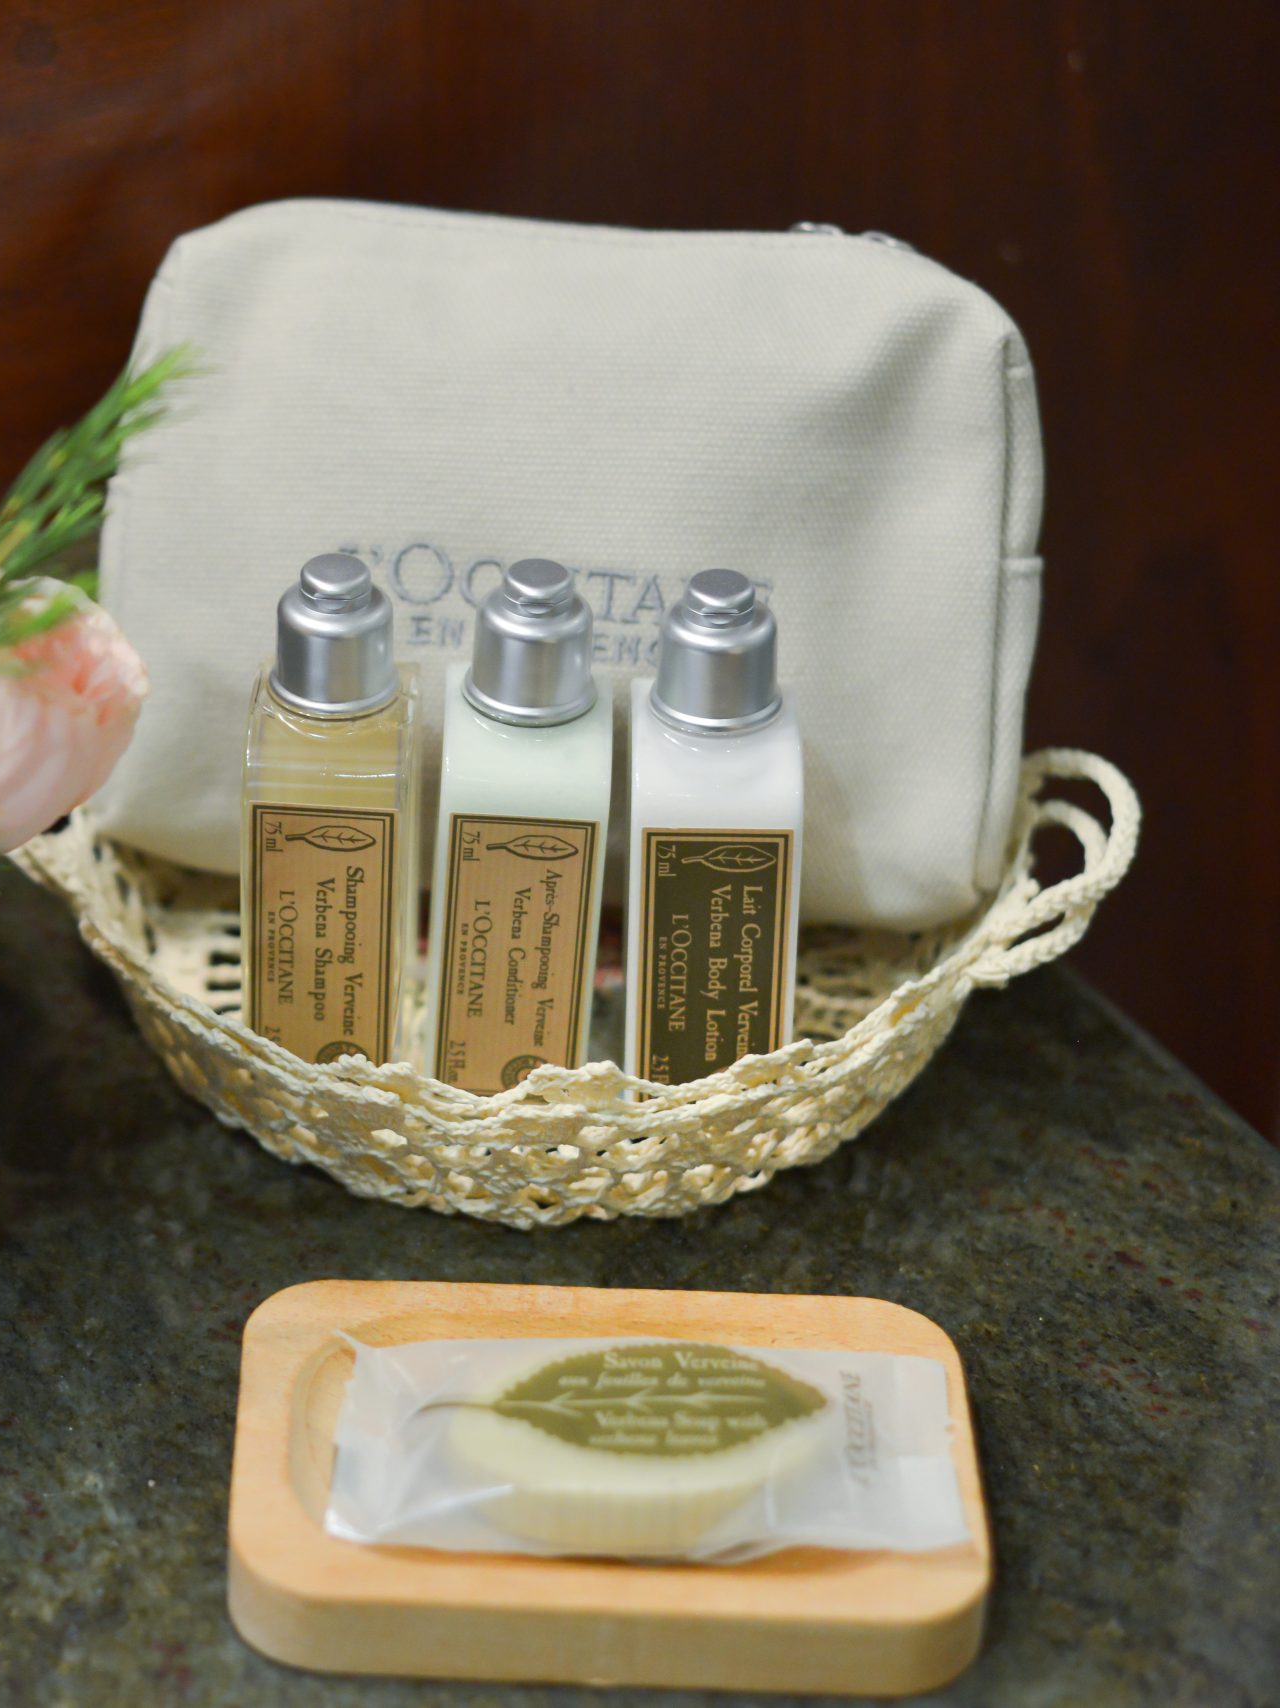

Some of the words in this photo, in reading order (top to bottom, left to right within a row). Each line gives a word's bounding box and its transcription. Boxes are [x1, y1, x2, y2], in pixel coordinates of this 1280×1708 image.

[408, 615, 465, 649] EN
[264, 821, 282, 836] 75
[265, 837, 283, 852] ml
[462, 831, 481, 846] 75
[462, 847, 480, 862] ml
[657, 844, 676, 861] 75
[658, 861, 677, 877] ml
[267, 911, 276, 924] EN
[315, 877, 335, 938] Verbena
[337, 866, 365, 964] Shampooing
[511, 887, 532, 940] Verbena
[709, 884, 732, 948] Verbena
[742, 885, 763, 915] Lait
[266, 928, 276, 983] PROVENCE
[278, 889, 298, 1005] L'OCCITANE
[461, 923, 469, 936] EN
[531, 868, 562, 990] Après-Shampooing
[659, 936, 668, 950] EN
[456, 941, 468, 995] PROVENCE
[467, 899, 493, 1018] L'OCCITANE
[657, 954, 667, 1009] PROVENCE
[668, 914, 692, 1032] L'OCCITANE
[699, 957, 727, 1000] Body
[733, 922, 761, 993] Corporel
[308, 948, 333, 1022] Shampoo
[343, 972, 363, 1036] Verveine
[504, 947, 526, 1025] Conditioner
[533, 998, 554, 1047] Verveine
[705, 1008, 725, 1061] Lotion
[603, 1351, 663, 1369] Savon
[674, 1351, 759, 1371] Verveine
